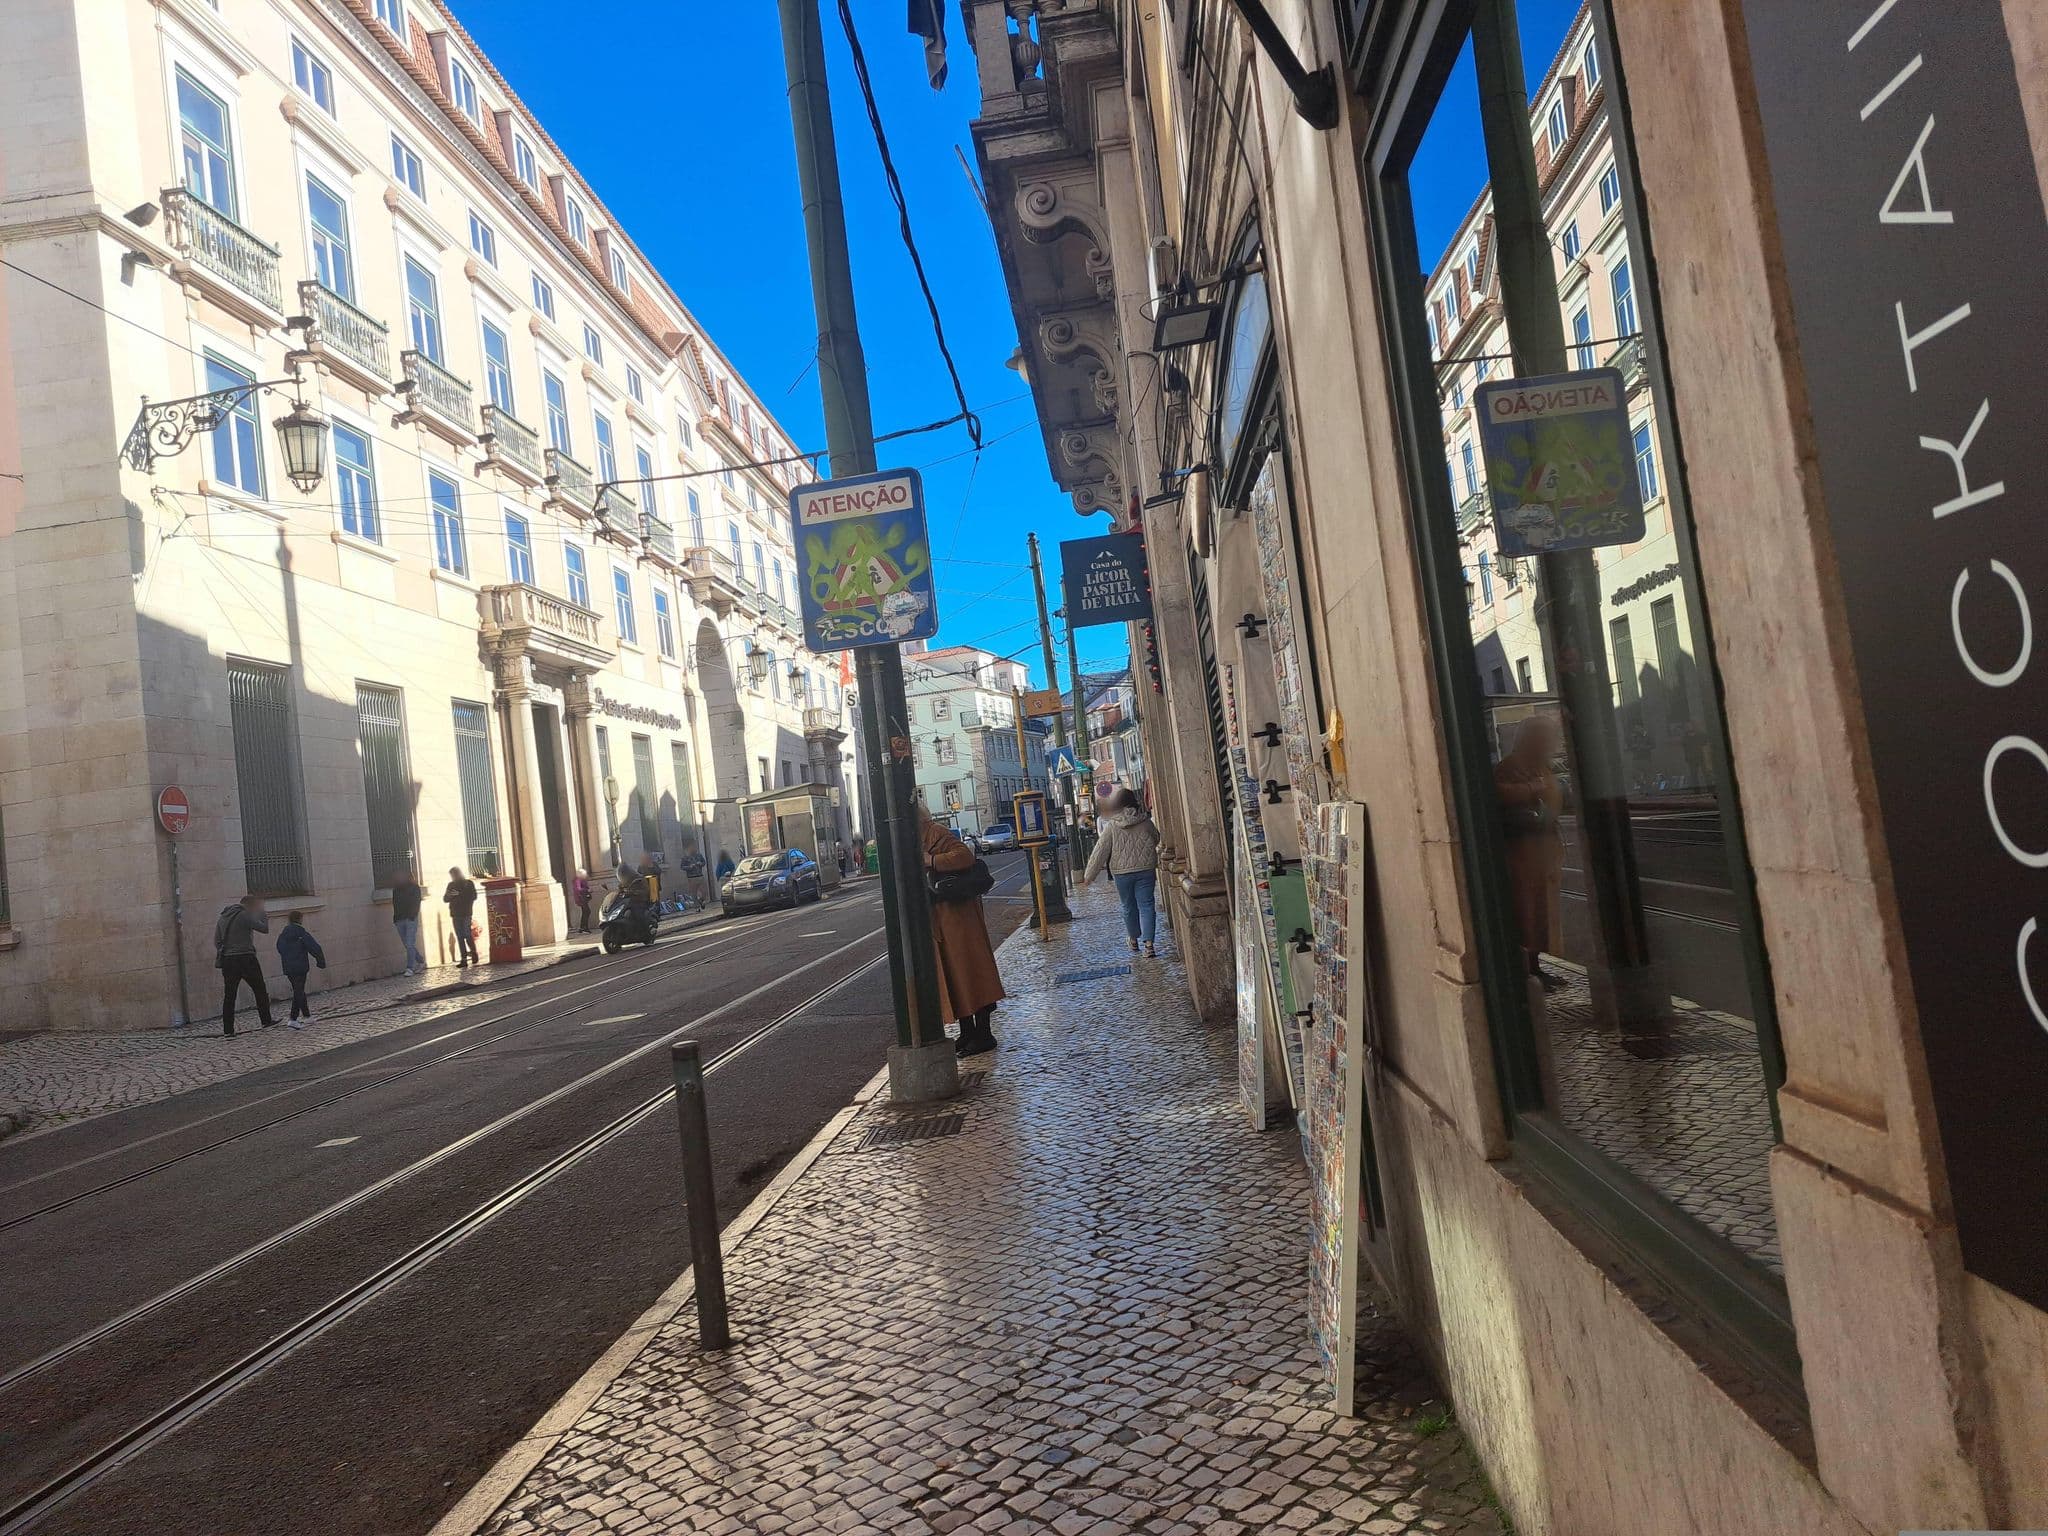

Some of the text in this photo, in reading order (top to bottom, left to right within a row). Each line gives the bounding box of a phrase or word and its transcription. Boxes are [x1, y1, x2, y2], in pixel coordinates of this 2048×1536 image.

[806, 484, 907, 518] ATENÇÃO
[1082, 580, 1136, 597] PASTEL
[1082, 592, 1140, 609] DE NATA
[847, 694, 856, 706] S
